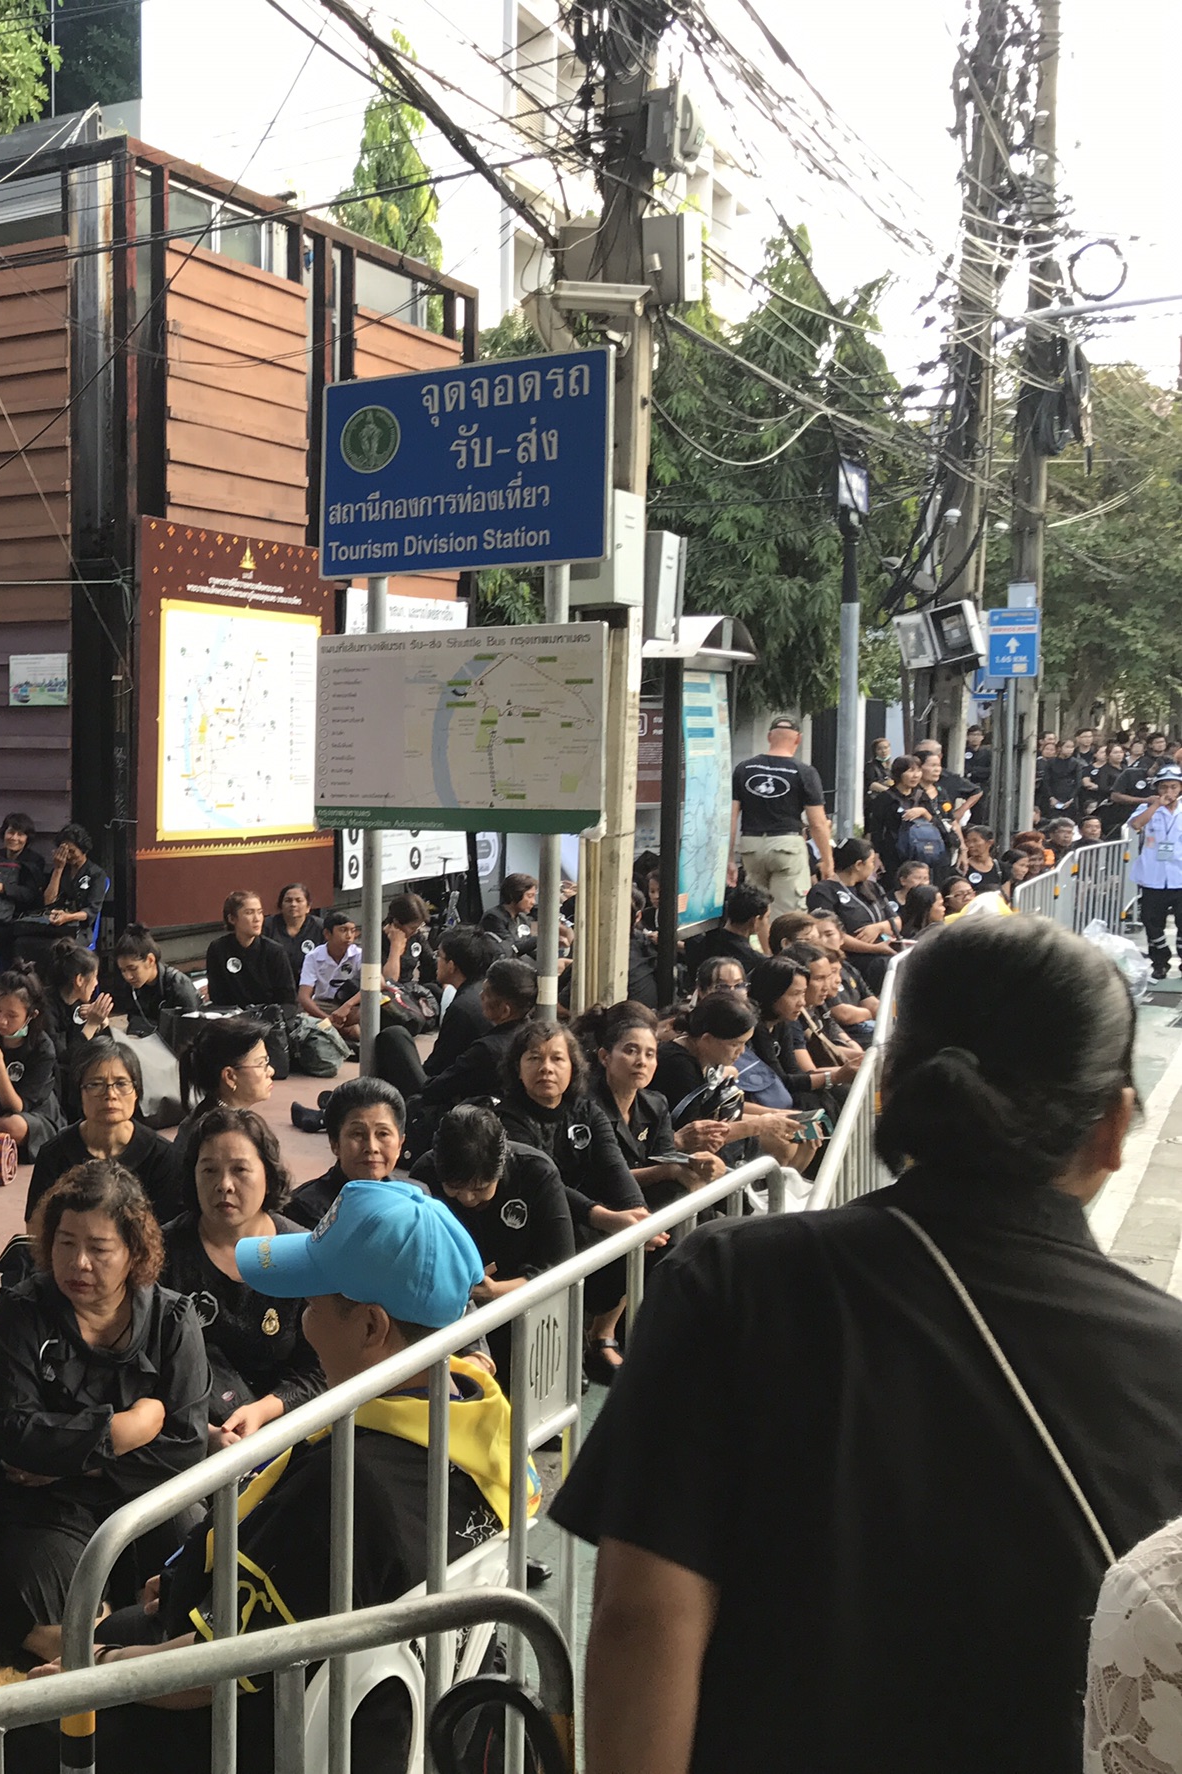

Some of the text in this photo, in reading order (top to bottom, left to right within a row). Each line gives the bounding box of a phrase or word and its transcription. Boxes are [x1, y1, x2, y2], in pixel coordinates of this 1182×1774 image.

[421, 363, 591, 427] จุดจอดรถ
[450, 416, 559, 470] รับ-ส่ง
[328, 471, 551, 525] สถานีกองการท่องเที่ยว
[328, 527, 551, 562] Tourism Division Station
[446, 636, 482, 649] Shuttle
[486, 635, 506, 647] Bus
[510, 632, 592, 648] กรุงเทพมหานคร
